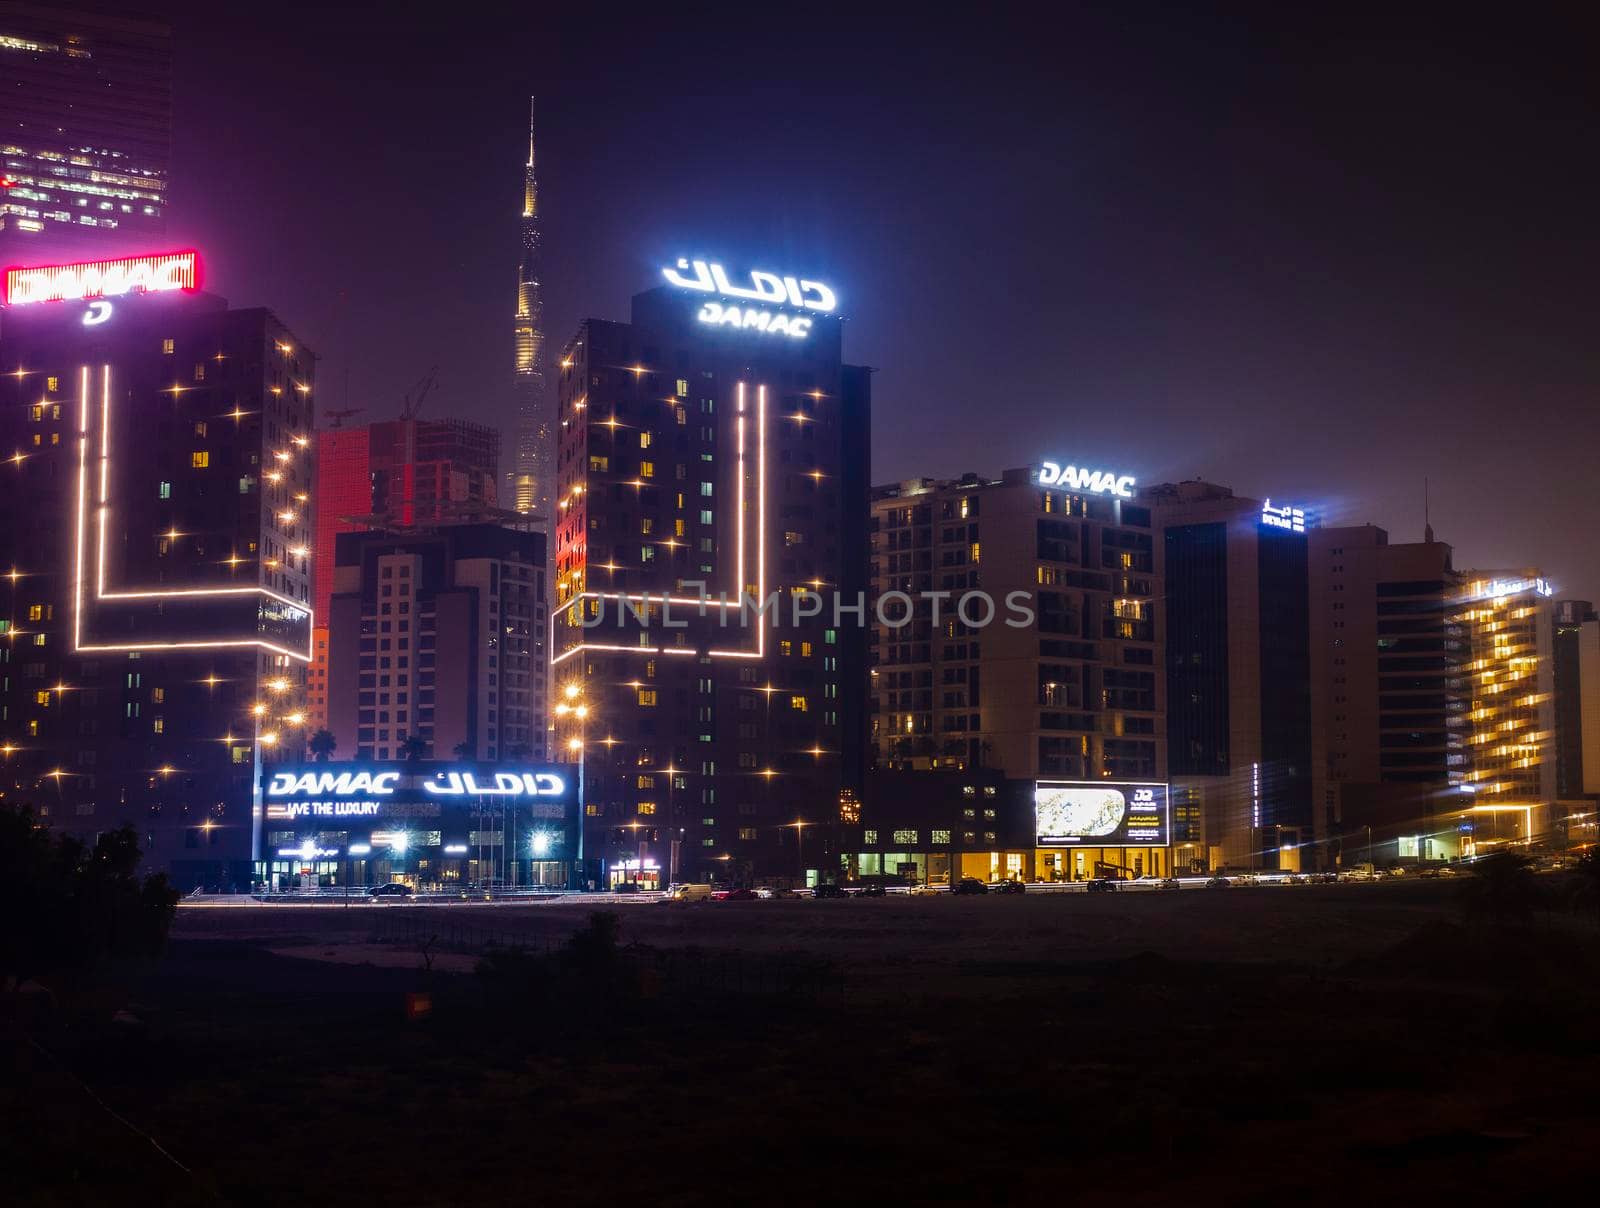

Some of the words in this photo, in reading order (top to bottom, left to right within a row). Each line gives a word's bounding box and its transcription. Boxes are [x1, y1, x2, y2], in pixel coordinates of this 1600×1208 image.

[698, 302, 812, 337] DAMAC
[1039, 461, 1136, 497] DAMAC
[268, 772, 400, 795] DAMAC
[312, 803, 333, 815] THE
[335, 802, 380, 815] LUXURY
